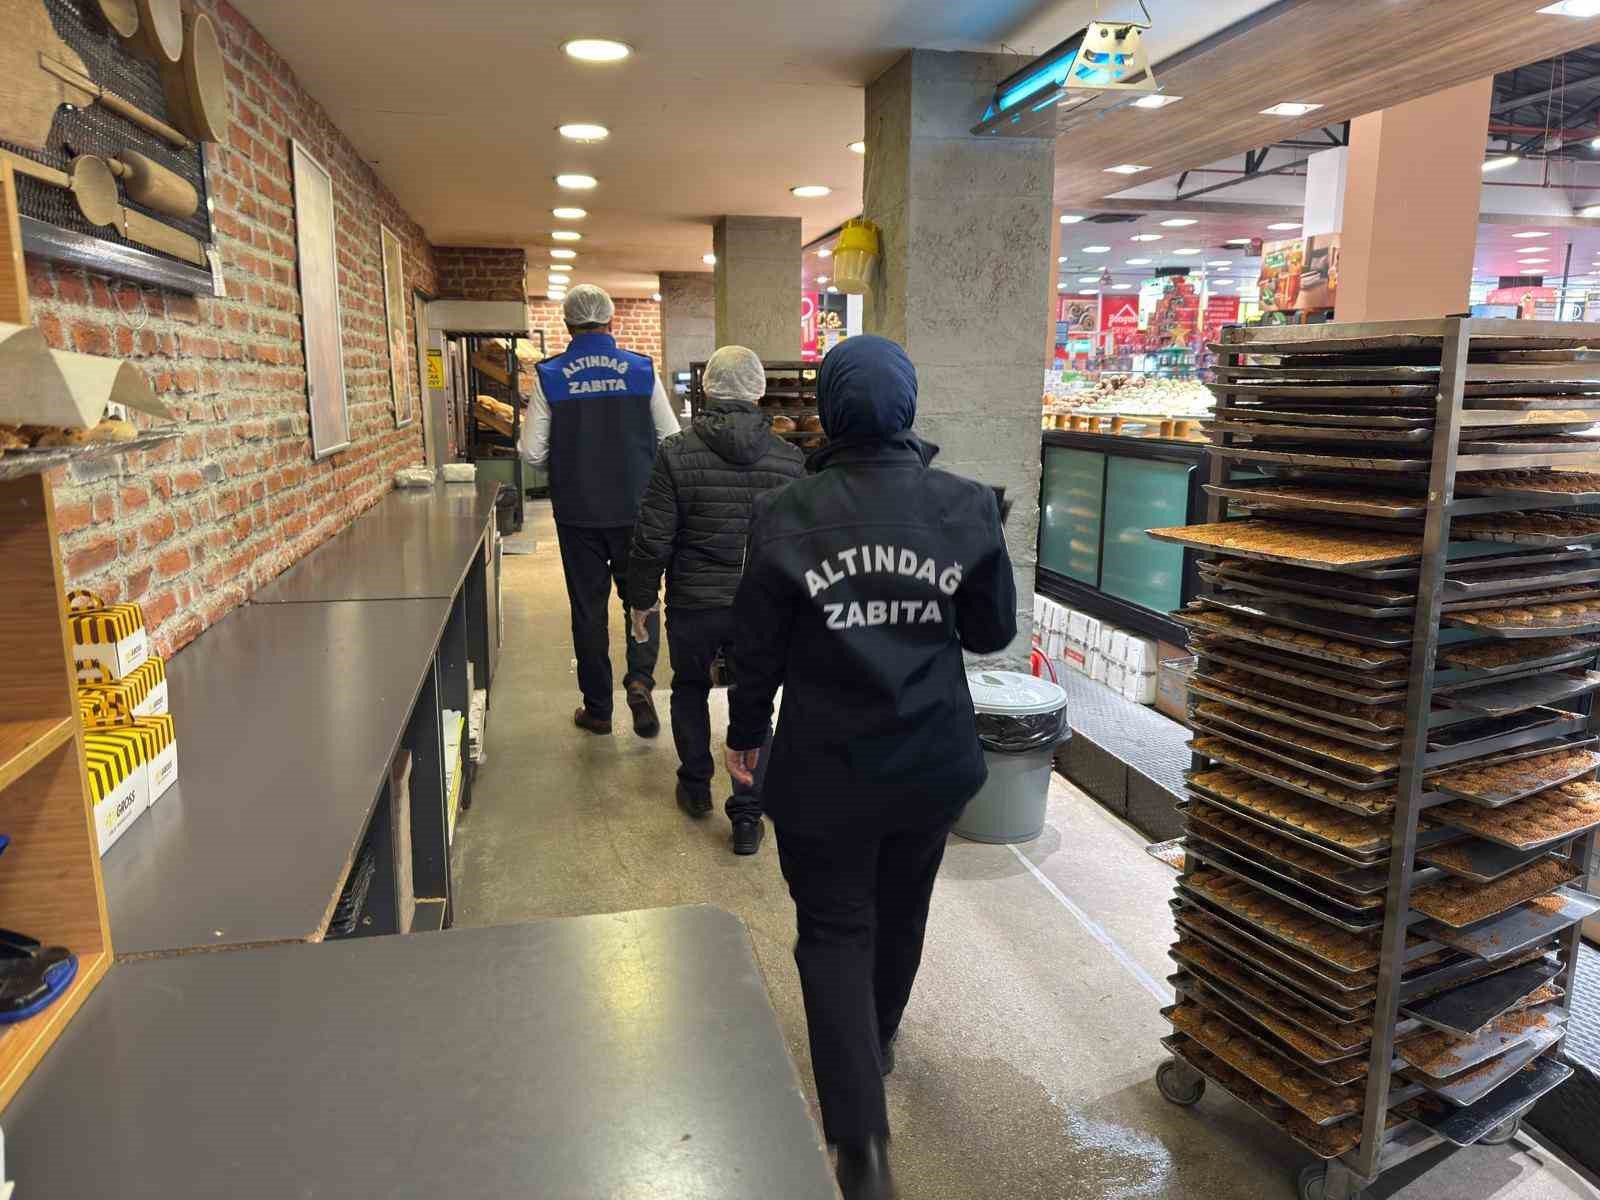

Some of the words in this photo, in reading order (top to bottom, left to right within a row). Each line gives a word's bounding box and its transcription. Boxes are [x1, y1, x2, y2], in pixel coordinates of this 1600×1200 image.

[562, 355, 629, 378] ALTINDAĞ
[568, 379, 627, 394] ZABITA
[804, 544, 963, 597] ALTINDAĞ
[823, 600, 943, 630] ZABITA
[116, 790, 136, 817] GROSS
